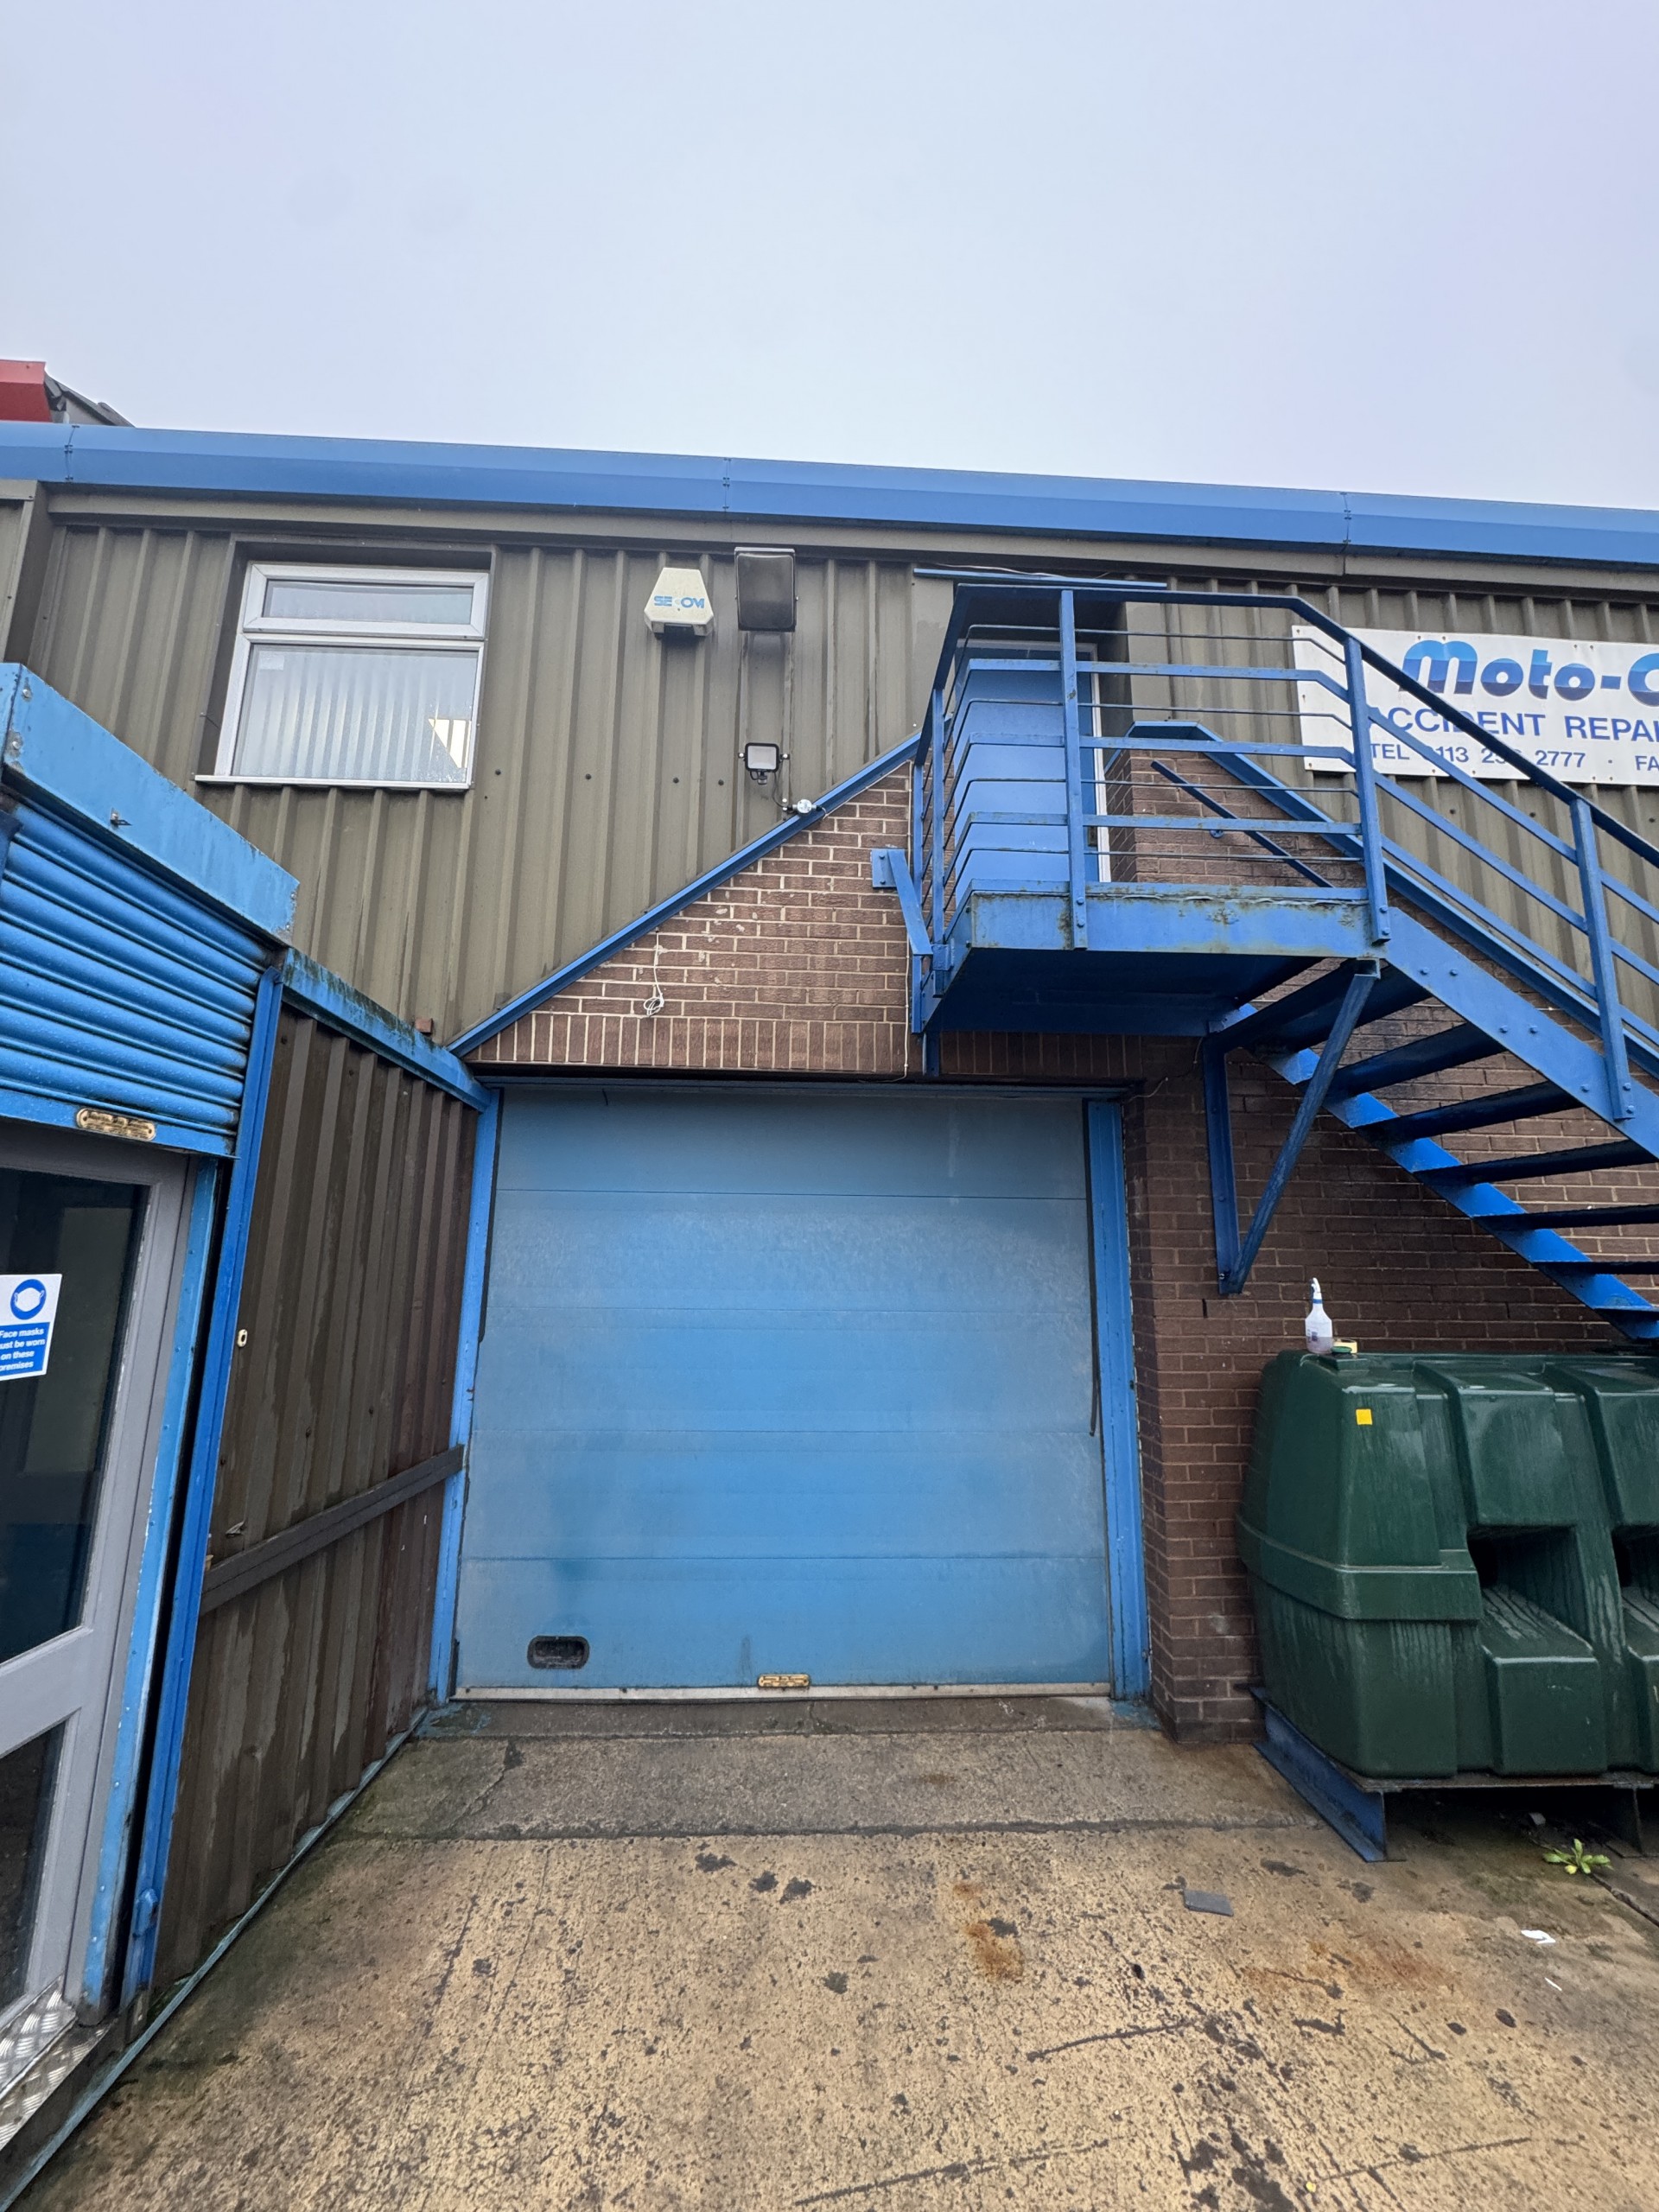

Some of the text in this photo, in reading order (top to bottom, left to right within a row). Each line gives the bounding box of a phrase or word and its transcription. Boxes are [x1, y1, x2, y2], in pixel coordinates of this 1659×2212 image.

[654, 595, 705, 609] SEOM
[1387, 707, 1546, 736] CCIENT
[1370, 743, 1410, 760] TEL
[1433, 746, 1469, 763] 113
[1535, 749, 1586, 768] 2777
[19, 1328, 44, 1337] masks
